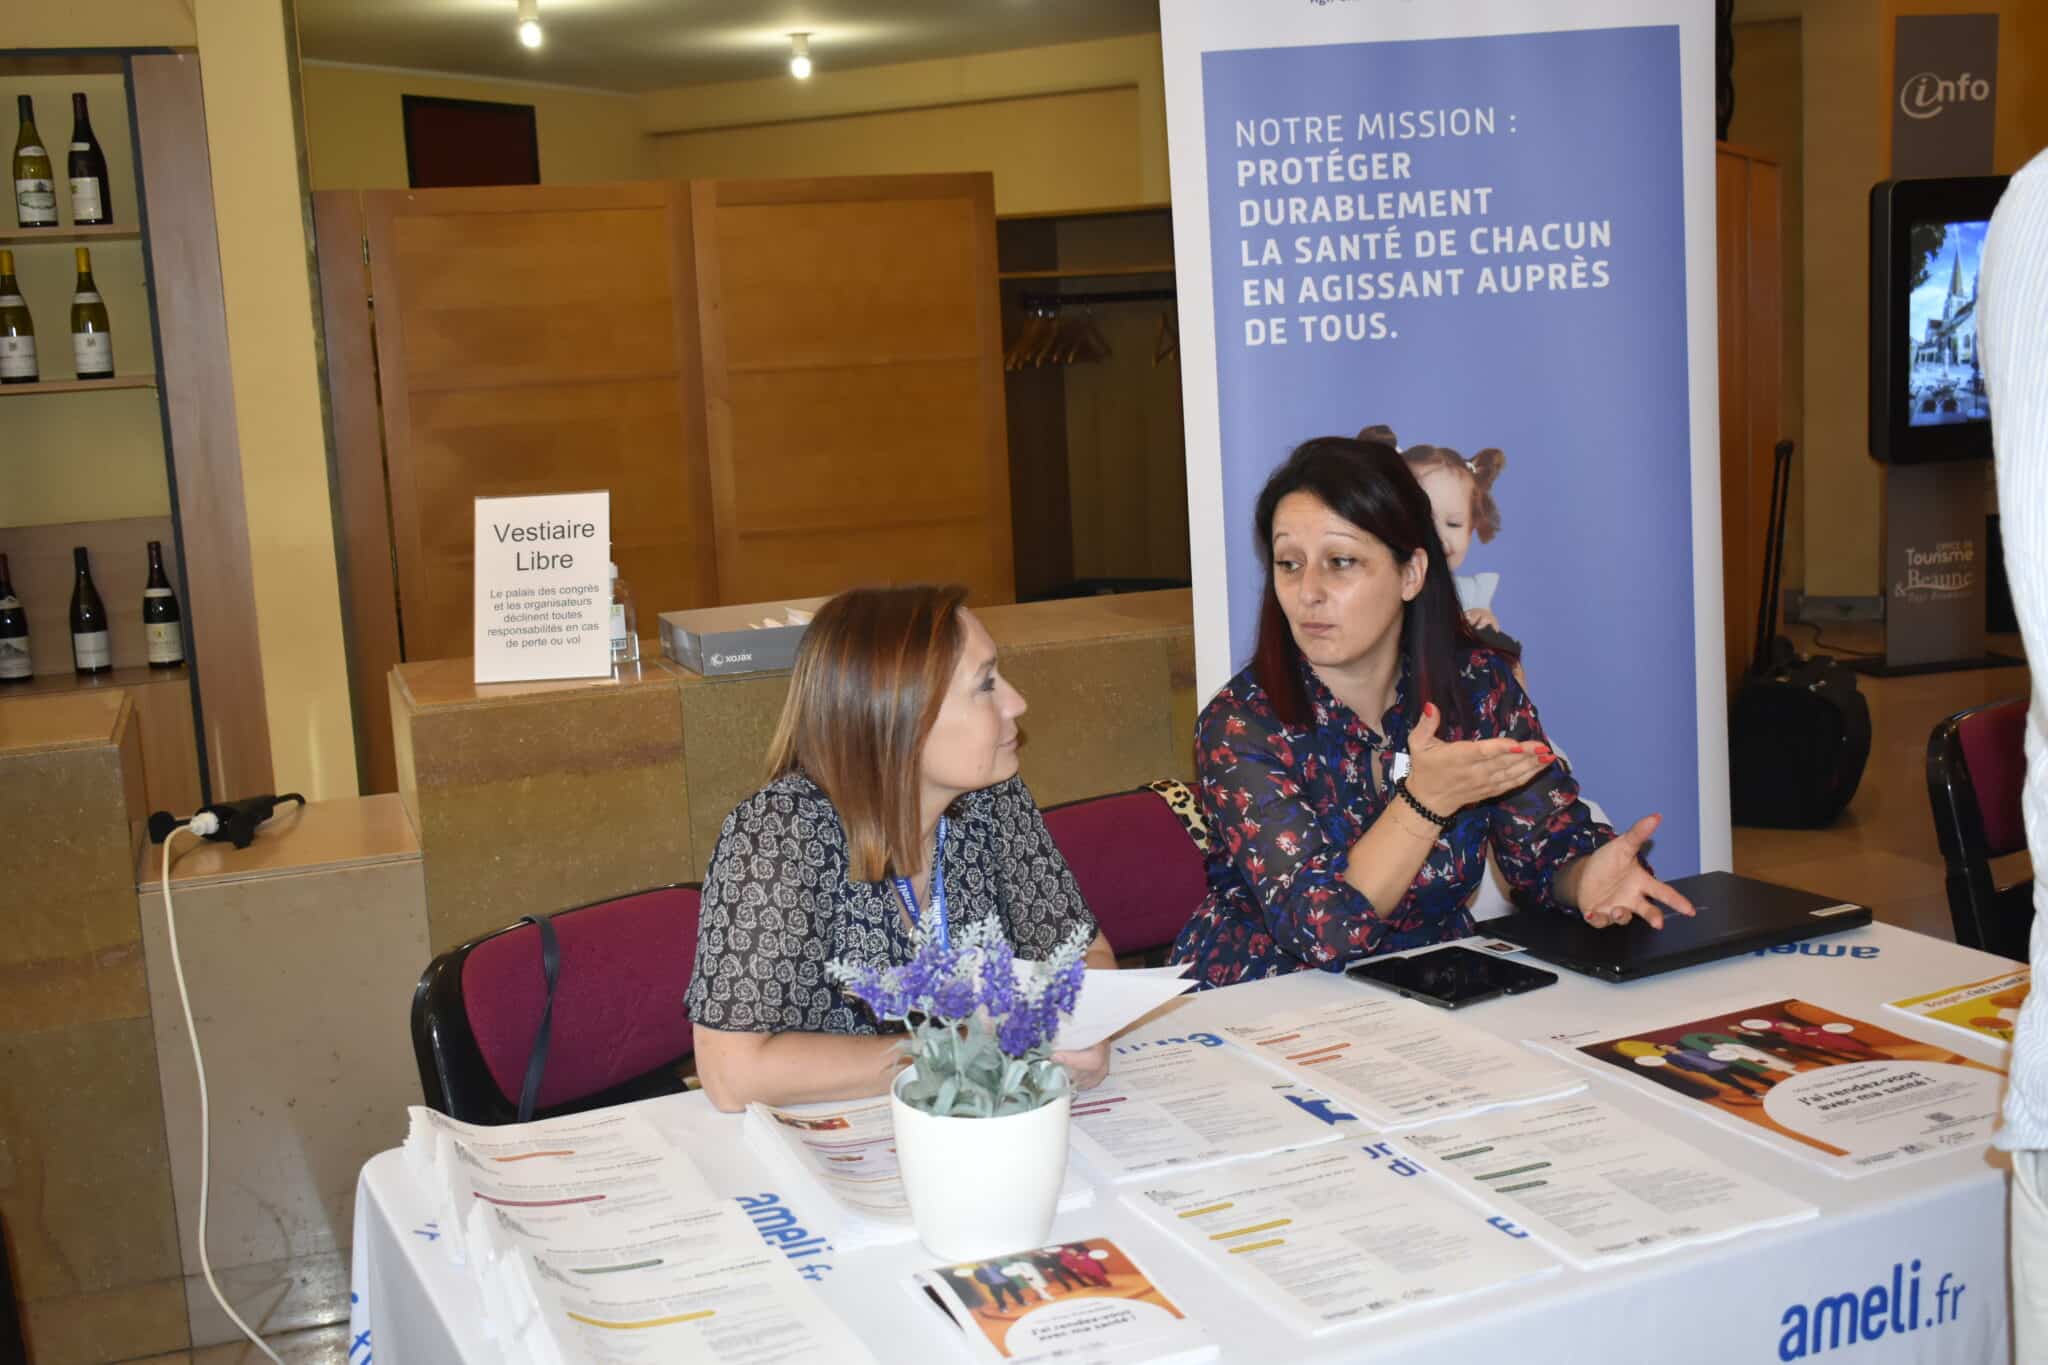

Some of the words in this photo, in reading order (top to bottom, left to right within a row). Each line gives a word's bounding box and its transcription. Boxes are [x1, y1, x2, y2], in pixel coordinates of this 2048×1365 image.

[1235, 115, 1344, 147] NOTRE
[1357, 107, 1496, 142] MISSION
[1237, 149, 1412, 187] PROTÉGER
[1240, 187, 1493, 227] DURABLEMENT
[1241, 237, 1283, 267] LA
[1295, 225, 1402, 263] SANTÉ
[1415, 230, 1457, 259] DE
[1470, 220, 1612, 256] CHACUN
[1244, 277, 1286, 307] EN
[1298, 268, 1464, 303] AGISSANT
[1477, 255, 1610, 296] AUPRÈS
[1245, 318, 1288, 347] DE
[1299, 312, 1398, 343] TOUS.
[493, 520, 596, 544] Vestiaire
[516, 551, 574, 572] Libre
[490, 588, 503, 600] Le
[505, 585, 535, 600] palais
[538, 584, 557, 596] des
[559, 583, 599, 597] congrès
[493, 600, 504, 611] et
[505, 599, 521, 610] les
[523, 596, 592, 611] organisateurs
[503, 612, 549, 623] déclinent
[551, 609, 583, 621] toutes
[487, 622, 563, 638] responsabilités
[566, 623, 580, 633] en
[581, 621, 600, 632] cas
[505, 638, 518, 648] de
[521, 637, 547, 649] perte
[550, 637, 563, 646] ou
[566, 633, 581, 646] vol
[1752, 942, 1881, 959] ame
[1778, 1258, 1966, 1362] ameli.fr
